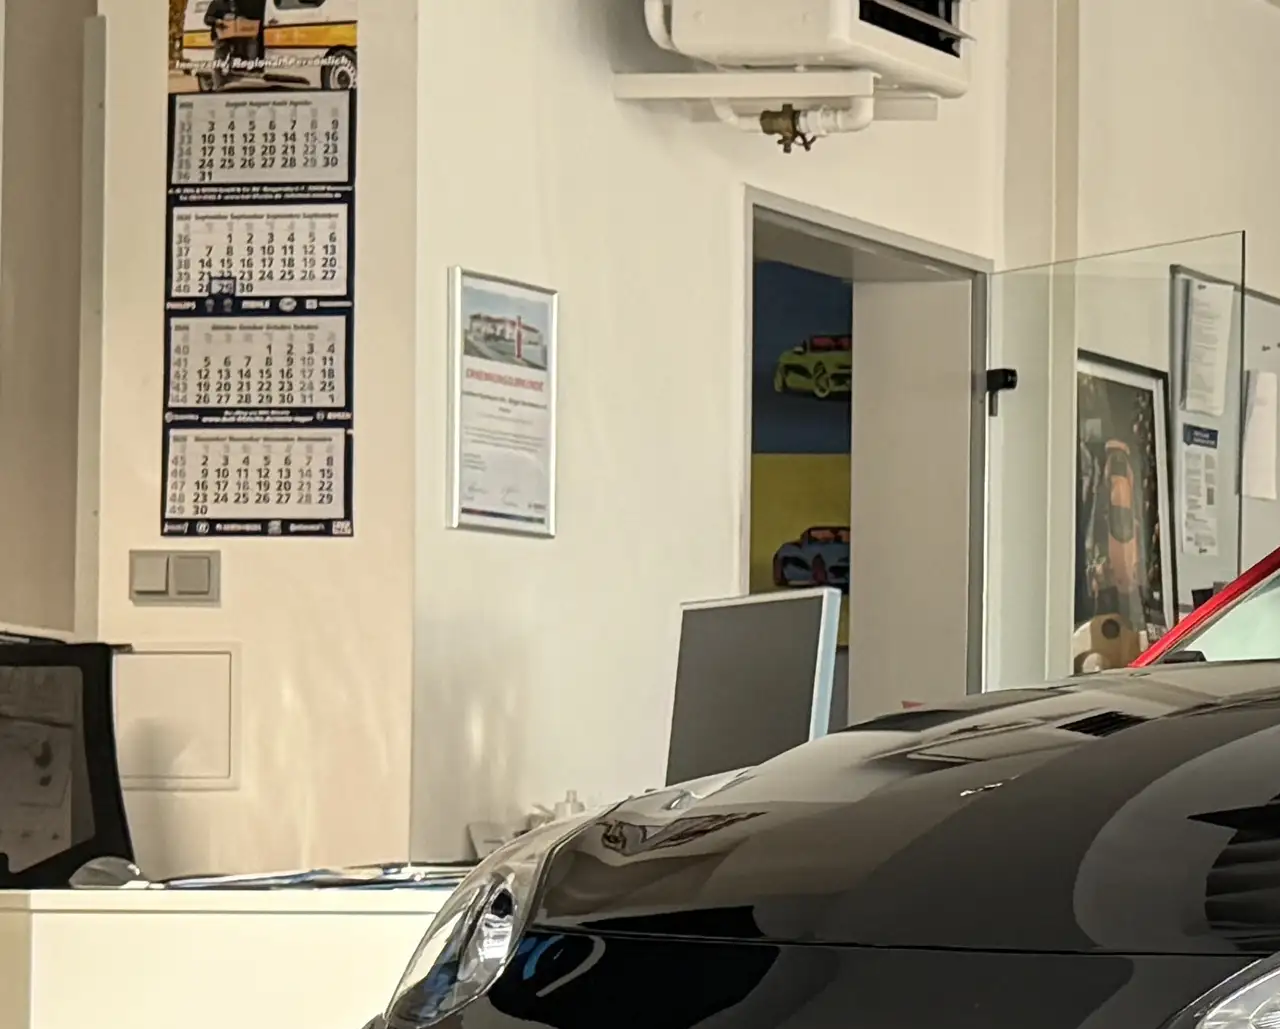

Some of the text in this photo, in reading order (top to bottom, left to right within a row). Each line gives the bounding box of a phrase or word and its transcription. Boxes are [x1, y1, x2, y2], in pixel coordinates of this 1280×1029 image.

[208, 121, 215, 132] 3
[228, 120, 235, 131] 4
[248, 120, 256, 131] 5
[269, 120, 276, 131] 6
[290, 120, 296, 130] 7
[331, 119, 338, 131] 9
[201, 133, 215, 144] 10
[222, 133, 235, 144] 11
[242, 133, 255, 144] 12
[262, 132, 276, 143] 13
[283, 132, 296, 143] 14
[325, 131, 338, 143] 16
[201, 146, 214, 157] 17
[221, 146, 235, 156] 18
[242, 145, 255, 157] 19
[261, 145, 275, 156] 20
[282, 144, 296, 156] 21
[324, 143, 338, 155] 23
[199, 158, 213, 169] 24
[220, 158, 234, 169] 25
[241, 158, 255, 169] 26
[261, 157, 275, 168] 27
[282, 157, 296, 168] 28
[324, 156, 338, 167] 30
[199, 170, 212, 182] 31
[226, 233, 232, 244] 1
[247, 233, 253, 244] 2
[267, 232, 274, 244] 3
[288, 232, 295, 243] 4
[329, 232, 336, 243] 6
[206, 246, 212, 257] 7
[246, 244, 254, 256] 9
[260, 245, 274, 257] 10
[281, 245, 294, 256] 11
[323, 244, 336, 255] 13
[198, 258, 212, 269] 14
[219, 258, 233, 269] 15
[240, 258, 253, 268] 16
[261, 257, 274, 268] 17
[281, 257, 294, 268] 18
[322, 257, 336, 268] 20
[239, 270, 253, 281] 23
[259, 270, 274, 281] 24
[280, 270, 294, 281] 25
[322, 269, 336, 280] 27
[239, 281, 253, 293] 30
[266, 344, 272, 355] 1
[286, 344, 293, 355] 2
[307, 343, 314, 354] 3
[327, 343, 335, 354] 4
[204, 356, 211, 368] 5
[224, 356, 231, 368] 6
[244, 356, 251, 367] 7
[265, 356, 272, 367] 8
[286, 355, 293, 368] 9
[322, 356, 334, 366] 11
[197, 368, 210, 380] 12
[217, 368, 231, 380] 13
[238, 369, 251, 380] 14
[259, 368, 272, 379] 15
[279, 368, 293, 379] 16
[321, 368, 335, 379] 18
[196, 381, 210, 393] 19
[216, 381, 231, 392] 20
[237, 381, 251, 392] 21
[258, 381, 272, 392] 22
[279, 381, 293, 392] 23
[320, 381, 334, 392] 25
[196, 393, 210, 404] 26
[217, 393, 230, 404] 27
[237, 393, 251, 404] 28
[258, 393, 272, 404] 29
[279, 393, 293, 404] 30
[328, 392, 334, 403] 1
[201, 456, 208, 466] 2
[222, 455, 229, 467] 3
[242, 456, 250, 466] 4
[263, 455, 270, 467] 5
[284, 455, 291, 466] 6
[326, 455, 333, 466] 8
[201, 468, 208, 480] 9
[215, 468, 229, 480] 10
[236, 468, 249, 479] 11
[256, 468, 270, 479] 12
[278, 468, 291, 479] 13
[319, 468, 333, 479] 15
[195, 480, 208, 492] 16
[215, 480, 228, 492] 17
[256, 480, 270, 492] 19
[277, 480, 291, 491] 20
[319, 480, 333, 491] 22
[193, 492, 208, 504] 23
[214, 492, 228, 503] 24
[235, 493, 249, 504] 25
[256, 492, 270, 504] 26
[276, 493, 291, 504] 27
[318, 492, 333, 504] 29
[194, 505, 208, 515] 30
